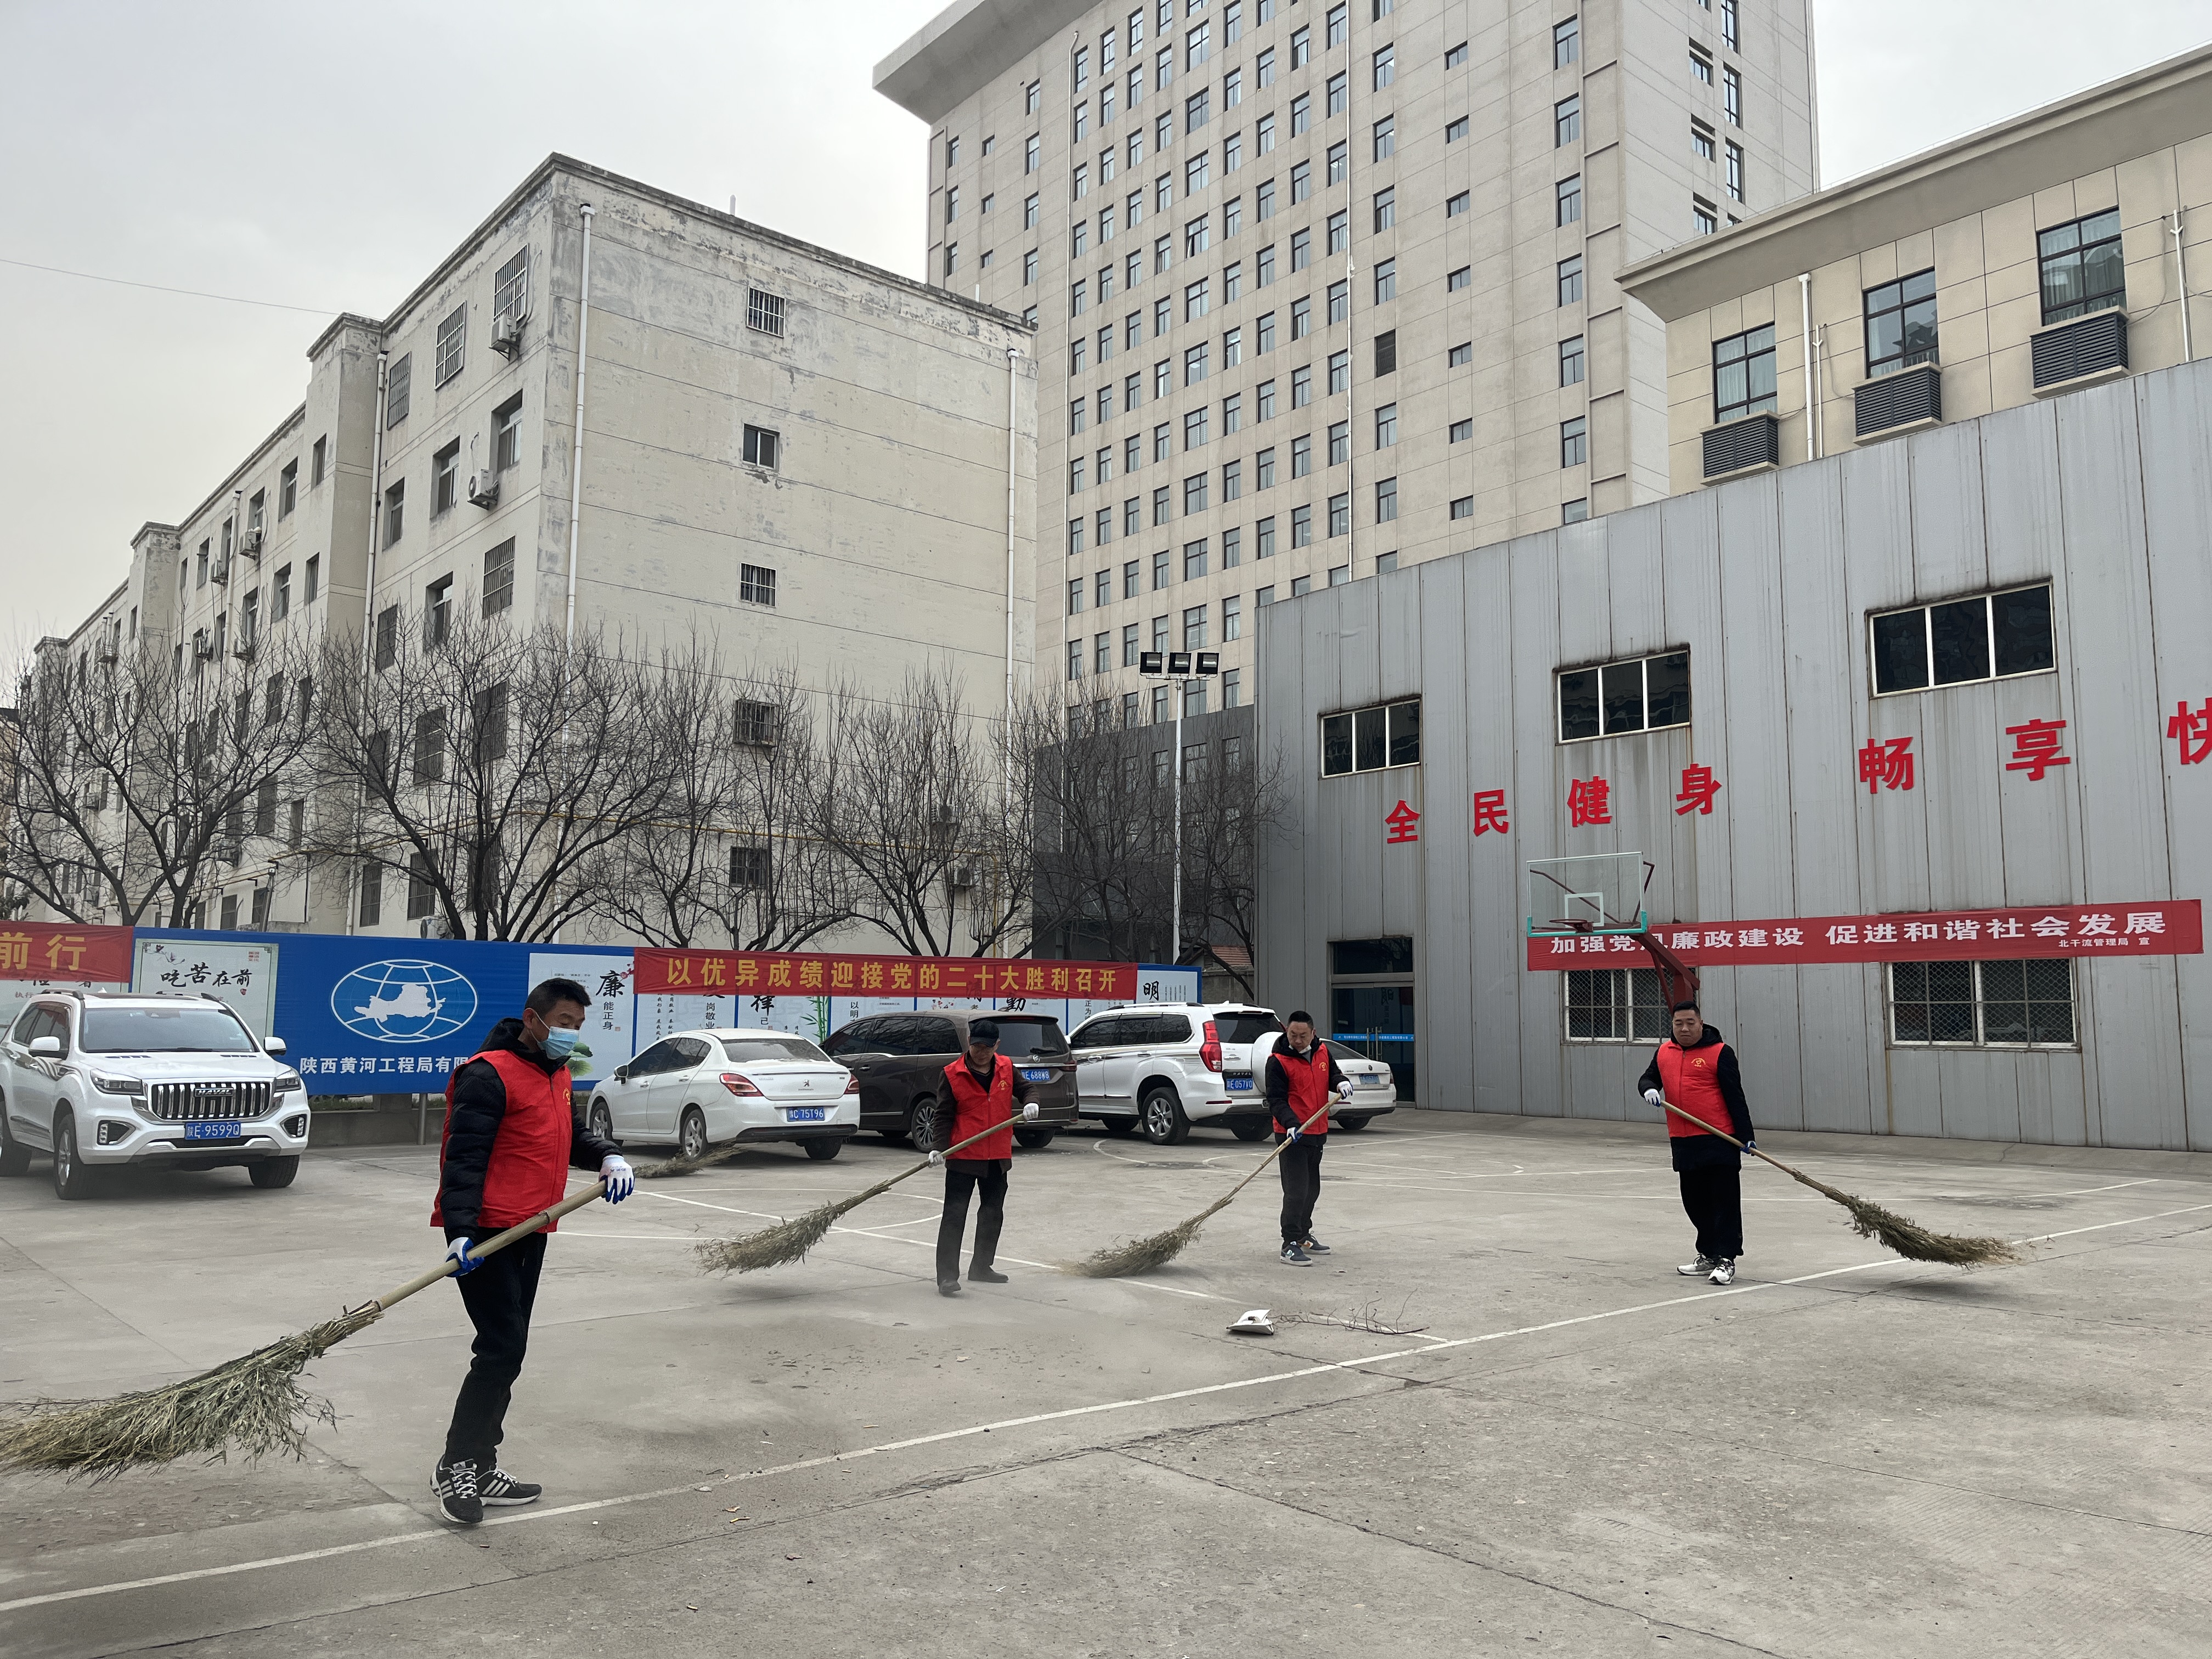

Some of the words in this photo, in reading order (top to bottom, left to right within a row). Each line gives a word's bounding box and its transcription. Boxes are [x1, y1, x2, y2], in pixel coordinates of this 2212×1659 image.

[1385, 763, 1722, 844] 全民健身
[1825, 911, 2166, 945] 促进和谐社会发展
[2058, 938, 2129, 947] 北干流管理局
[2138, 937, 2150, 945] 宣
[0, 932, 87, 971] 前行
[160, 962, 252, 988] 吃苦在前
[667, 957, 1116, 992] 以优异成绩迎接党的二十大胜利召开
[602, 1001, 614, 1030] 能正身
